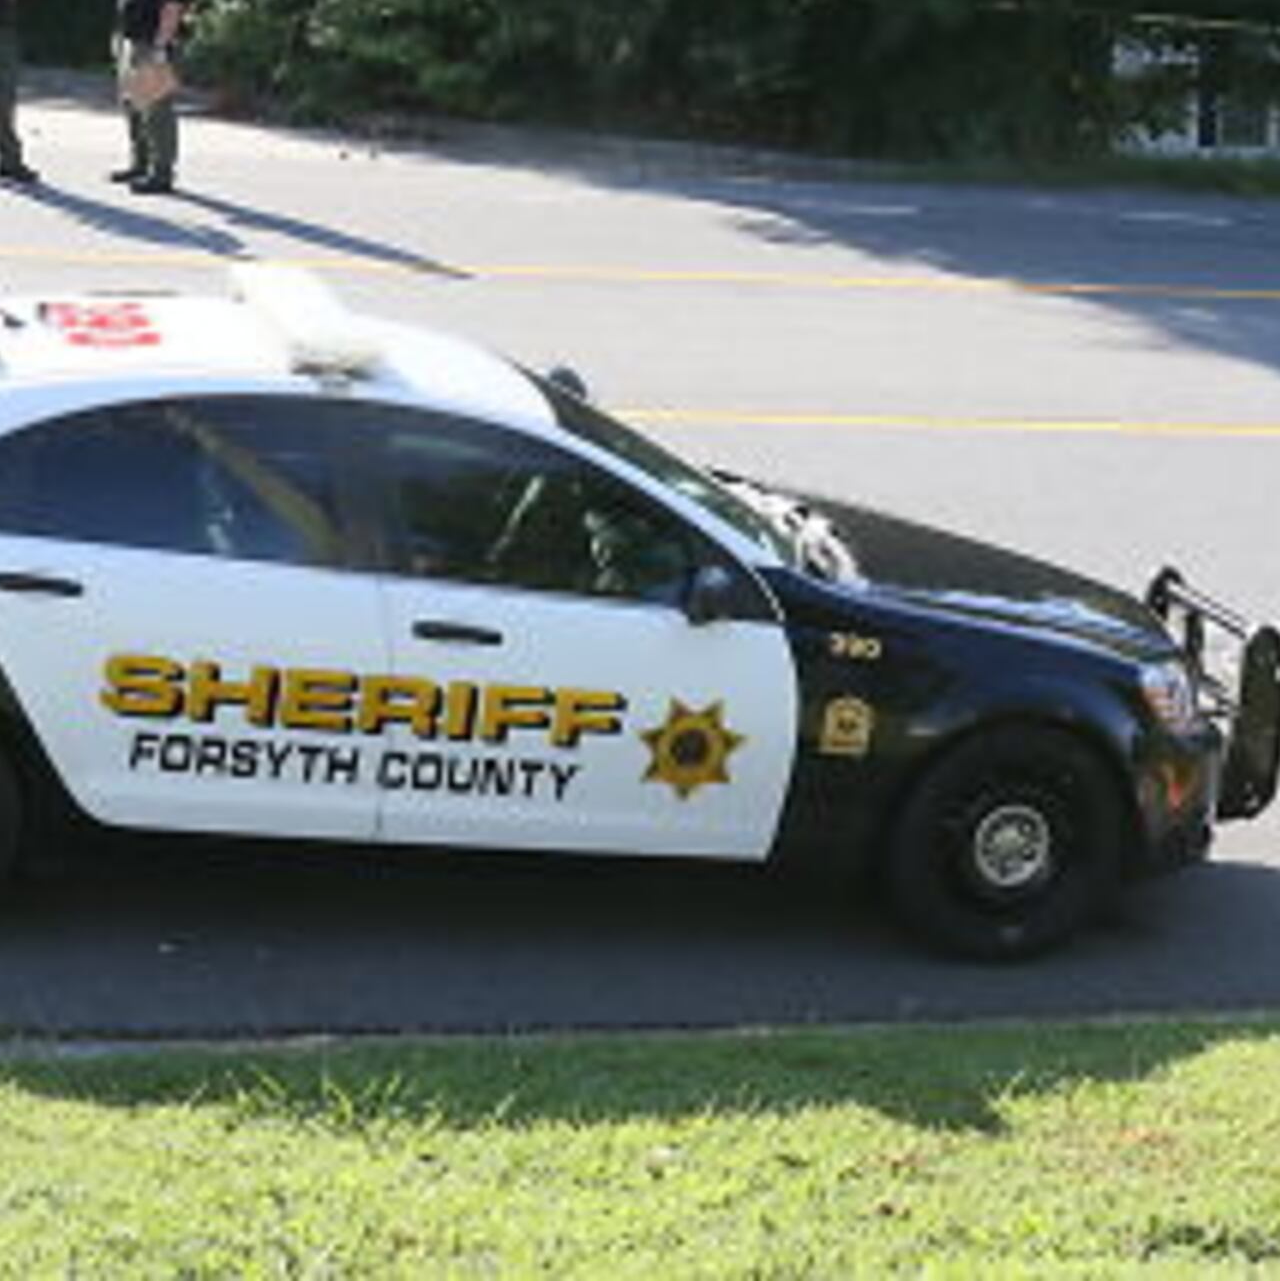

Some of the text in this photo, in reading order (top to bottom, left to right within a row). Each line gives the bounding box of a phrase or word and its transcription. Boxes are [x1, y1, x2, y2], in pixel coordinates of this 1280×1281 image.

[99, 654, 627, 748] SHERIFF
[128, 731, 582, 802] FORSYTH COUNTY
